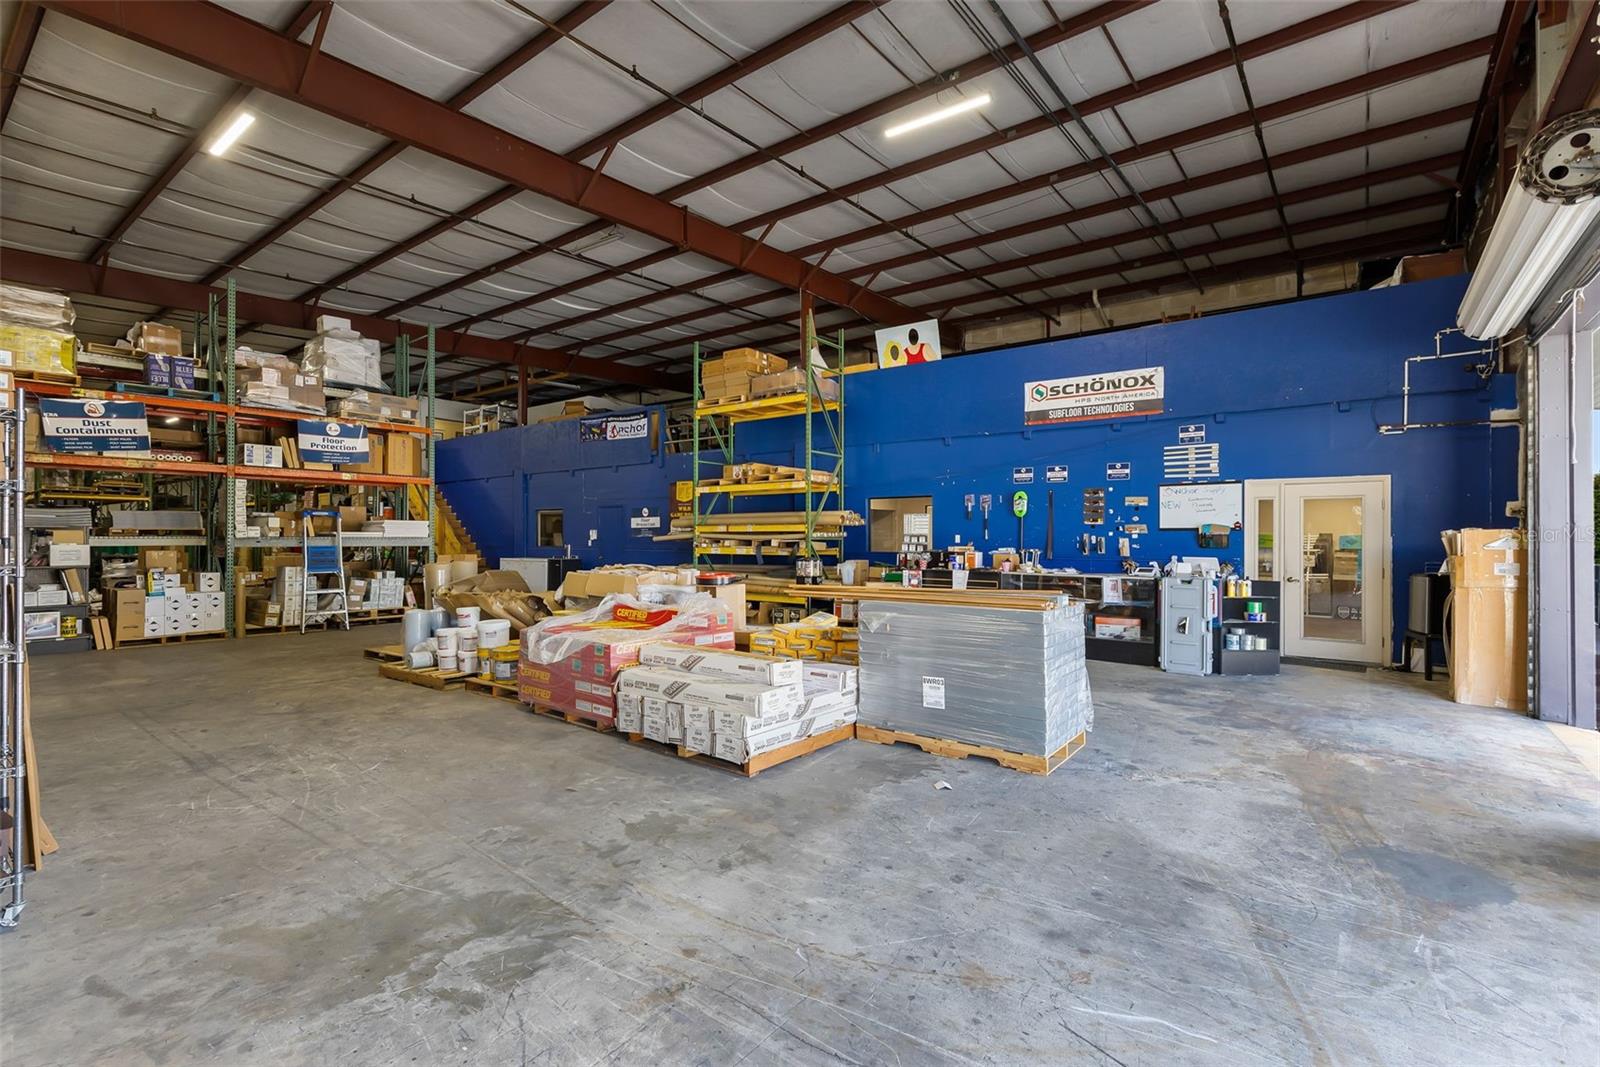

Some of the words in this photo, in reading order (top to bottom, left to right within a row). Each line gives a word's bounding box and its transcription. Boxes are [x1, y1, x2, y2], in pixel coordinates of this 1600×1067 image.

[1049, 374, 1155, 397] SCHÖNOX
[1122, 391, 1155, 399] AMERICA
[1049, 407, 1082, 419] SUBFLOOR
[1084, 402, 1135, 416] TECHNOLOGIES
[82, 419, 111, 427] Dust
[55, 426, 139, 435] Containment
[322, 437, 345, 445] Floor
[310, 442, 357, 451] Protection
[616, 608, 648, 620] CERTIFIED
